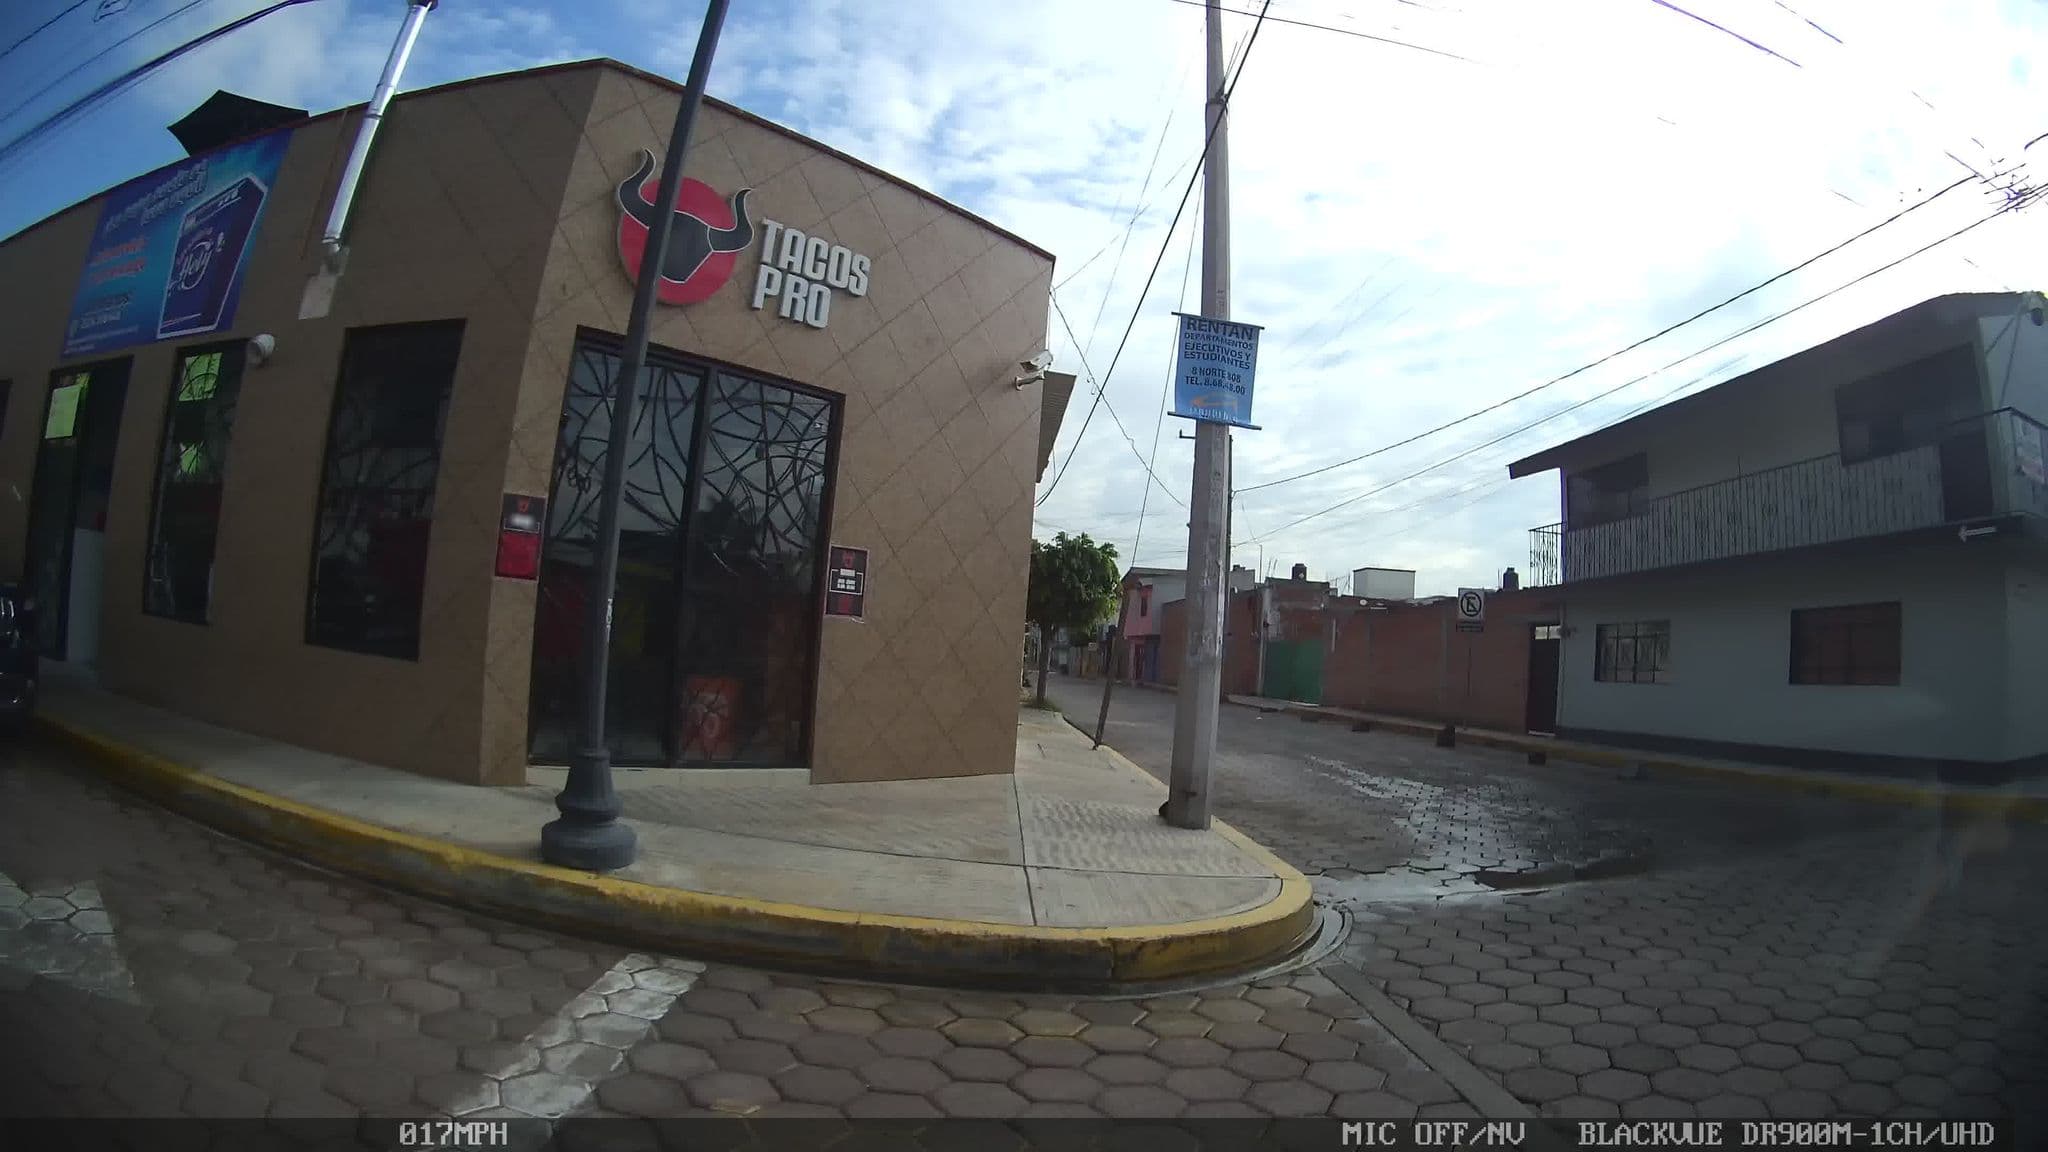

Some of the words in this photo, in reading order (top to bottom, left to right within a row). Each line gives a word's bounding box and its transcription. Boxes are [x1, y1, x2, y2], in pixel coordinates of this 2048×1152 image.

[762, 217, 871, 297] TACOS
[752, 264, 831, 328] PRO
[1187, 319, 1253, 340] RENTAN
[1184, 332, 1253, 350] DEPARTAMENTOS
[1184, 351, 1251, 370] ESTUDIANTES
[1185, 342, 1243, 359] EJECUTIVOS
[1244, 352, 1251, 361] Y
[1200, 367, 1227, 379] NORTE
